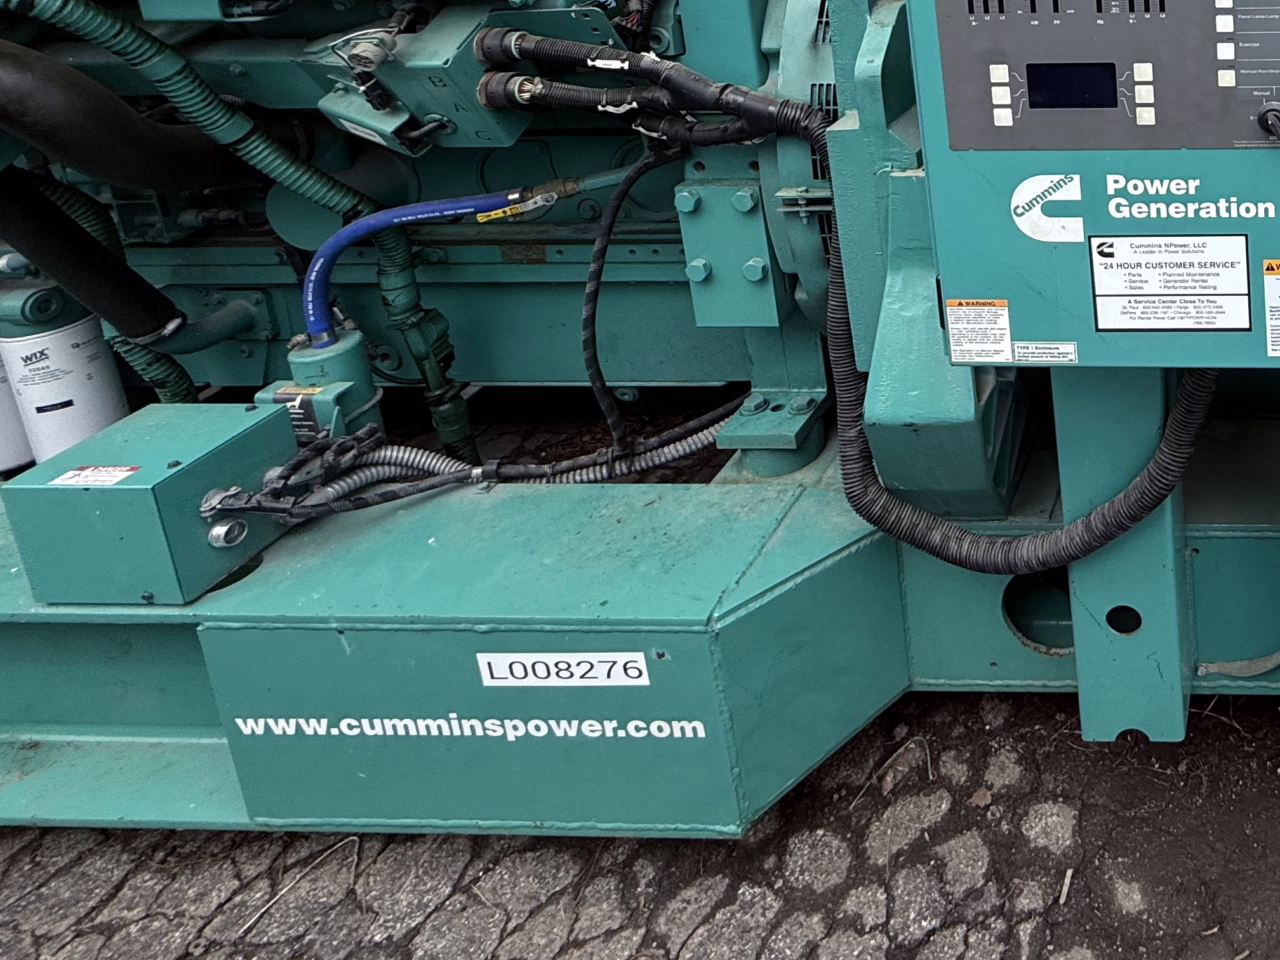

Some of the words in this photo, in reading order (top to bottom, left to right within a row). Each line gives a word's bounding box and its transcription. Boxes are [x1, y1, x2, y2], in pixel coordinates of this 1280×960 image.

[428, 76, 447, 88] B
[453, 102, 469, 113] A
[475, 130, 491, 140] C
[1106, 174, 1201, 195] Power
[1012, 174, 1075, 218] Cummins
[1108, 197, 1276, 219] Generation
[20, 348, 48, 364] WIX
[486, 659, 644, 681] L008276
[234, 712, 706, 742] www.cumminspower.com
